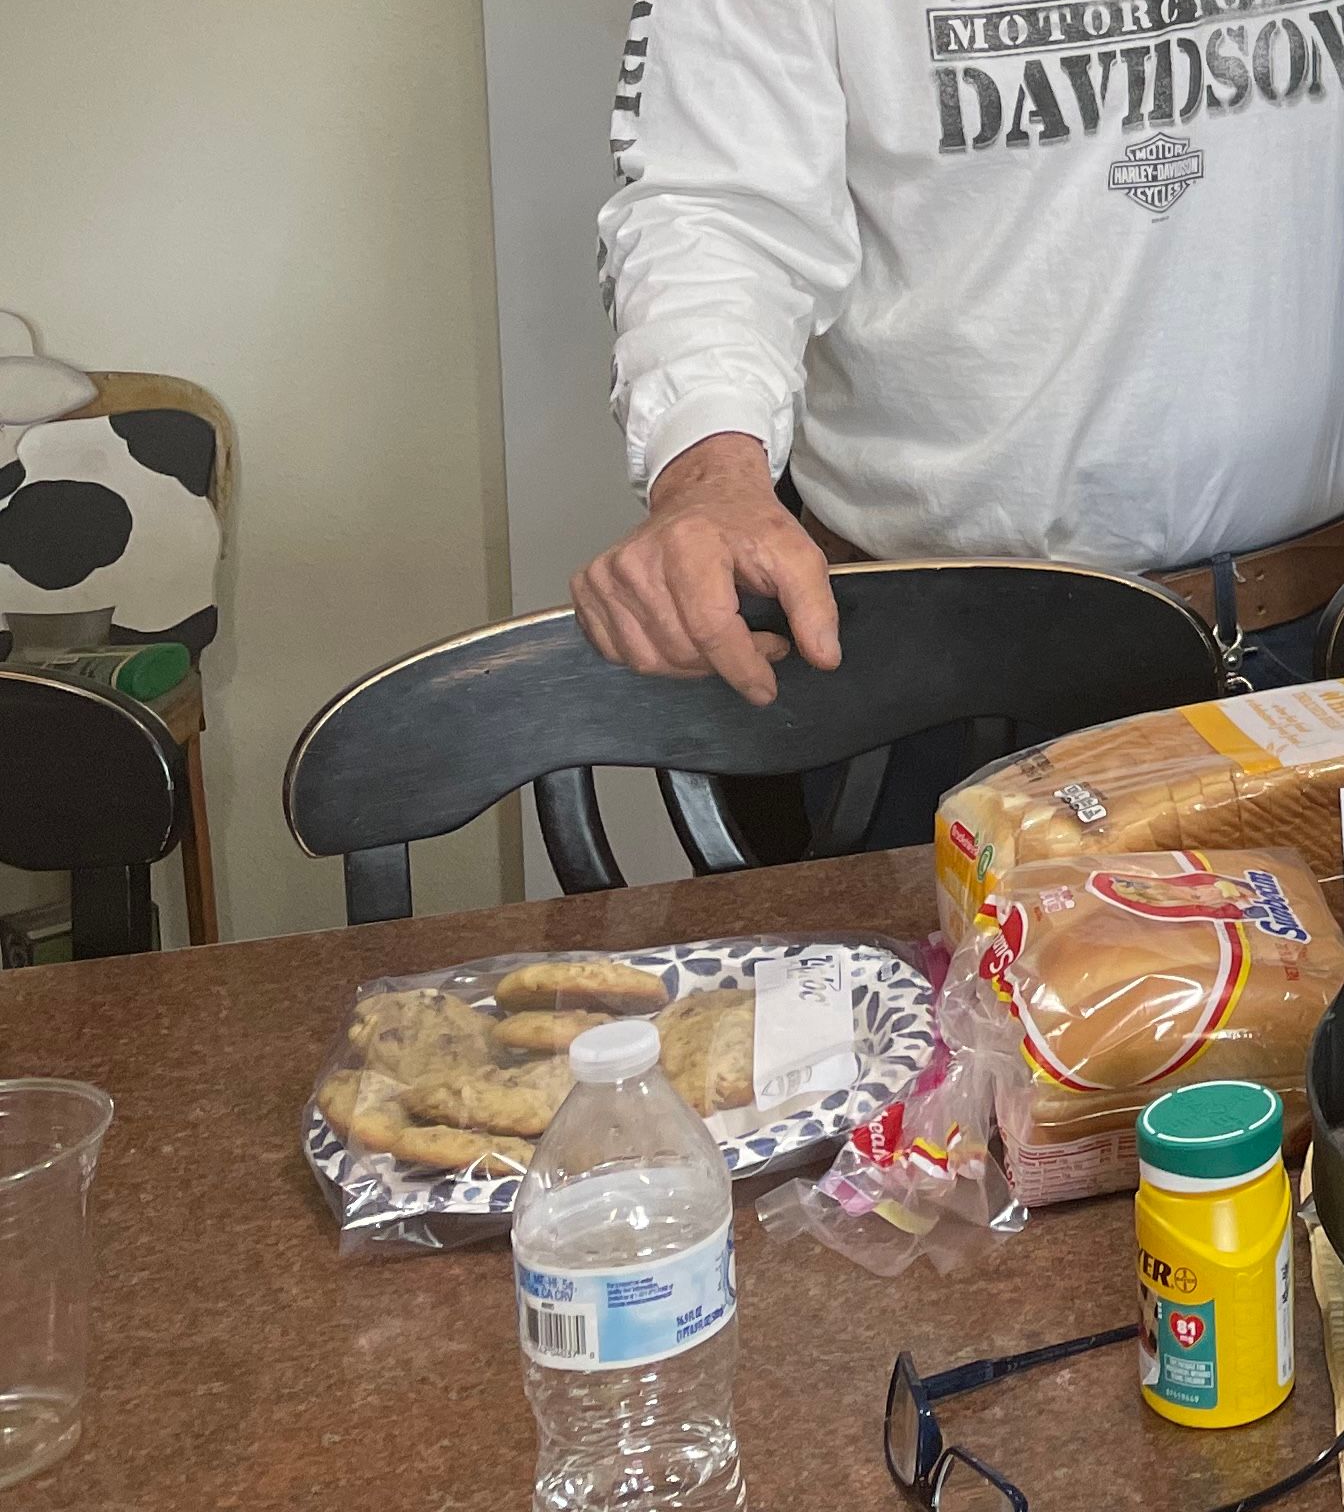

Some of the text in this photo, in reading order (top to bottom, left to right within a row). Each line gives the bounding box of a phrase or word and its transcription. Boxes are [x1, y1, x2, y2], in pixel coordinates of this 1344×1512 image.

[1135, 139, 1183, 161] MOTOR
[1136, 182, 1181, 207] CYCLES
[1176, 1319, 1197, 1336] 81
